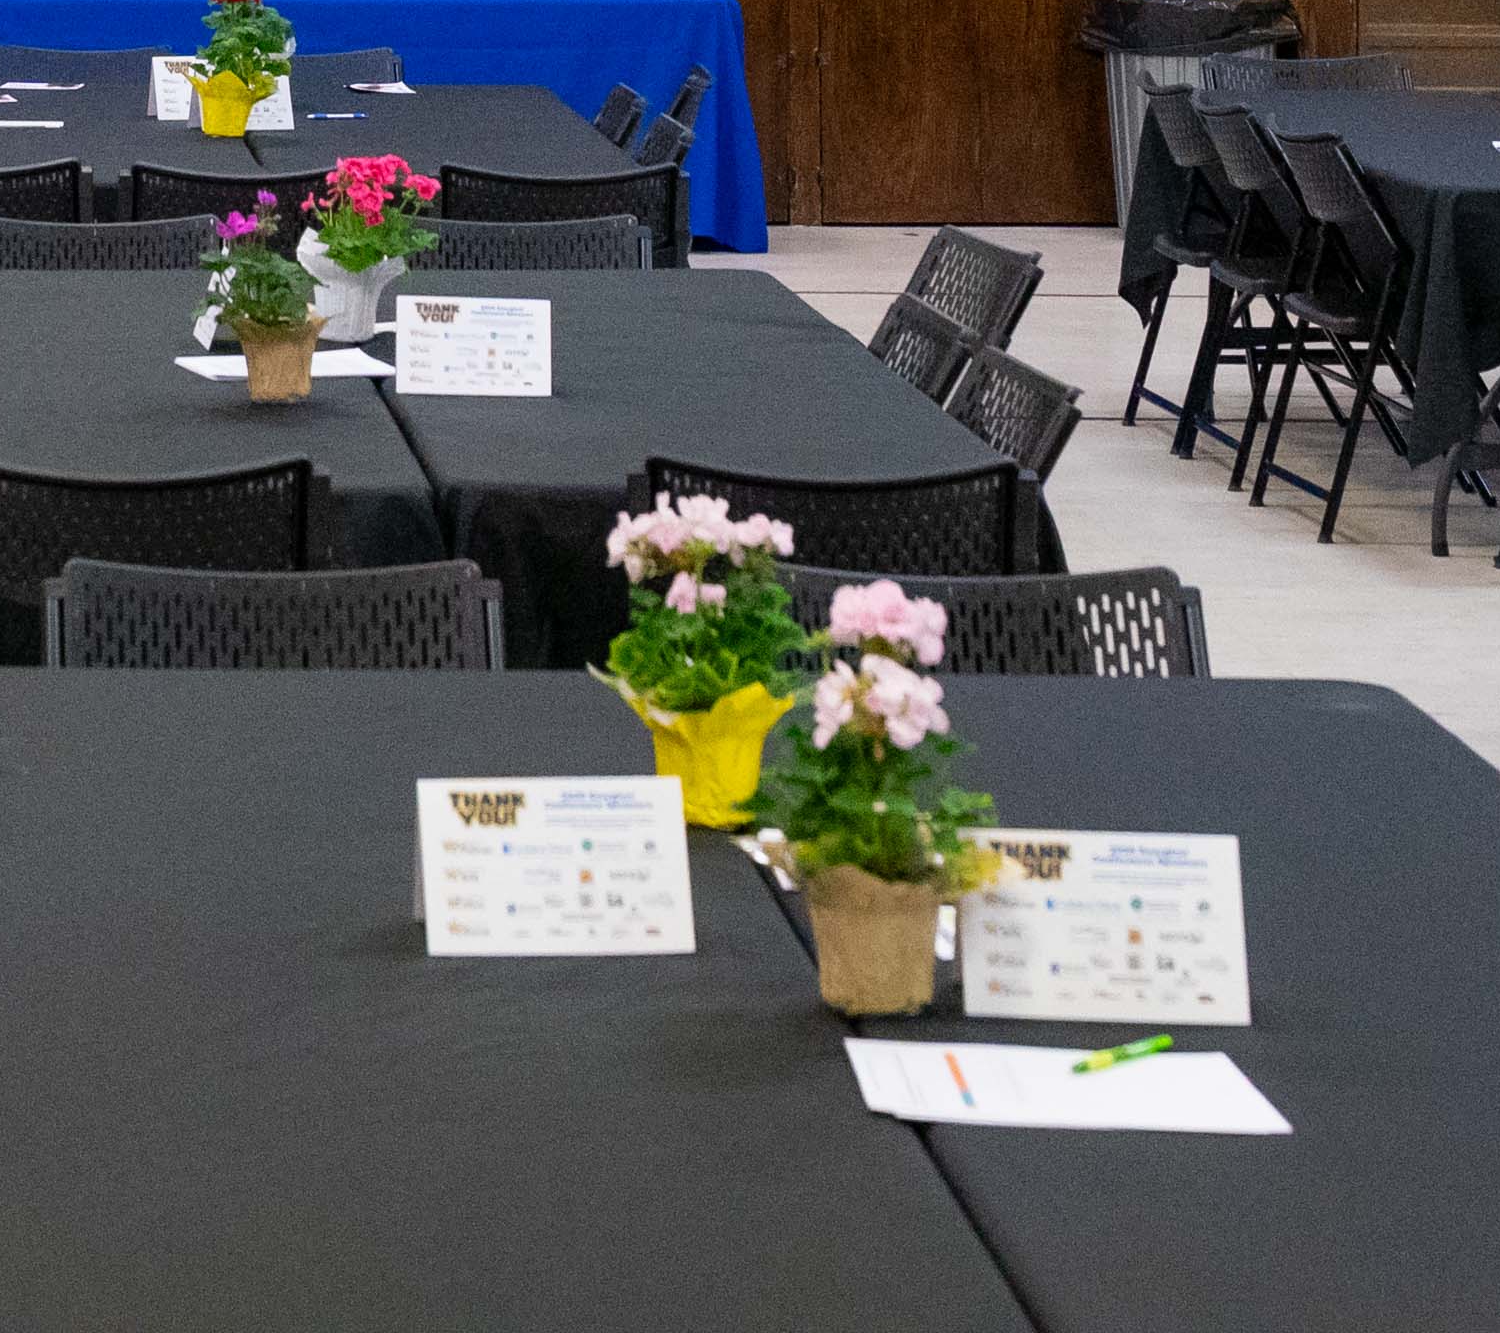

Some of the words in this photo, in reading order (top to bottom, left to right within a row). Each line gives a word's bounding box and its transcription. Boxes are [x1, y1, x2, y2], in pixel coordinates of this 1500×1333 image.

[415, 303, 459, 313] THANK
[420, 313, 455, 323] YOU!
[449, 792, 525, 808] THANK
[457, 807, 517, 827] YOU!
